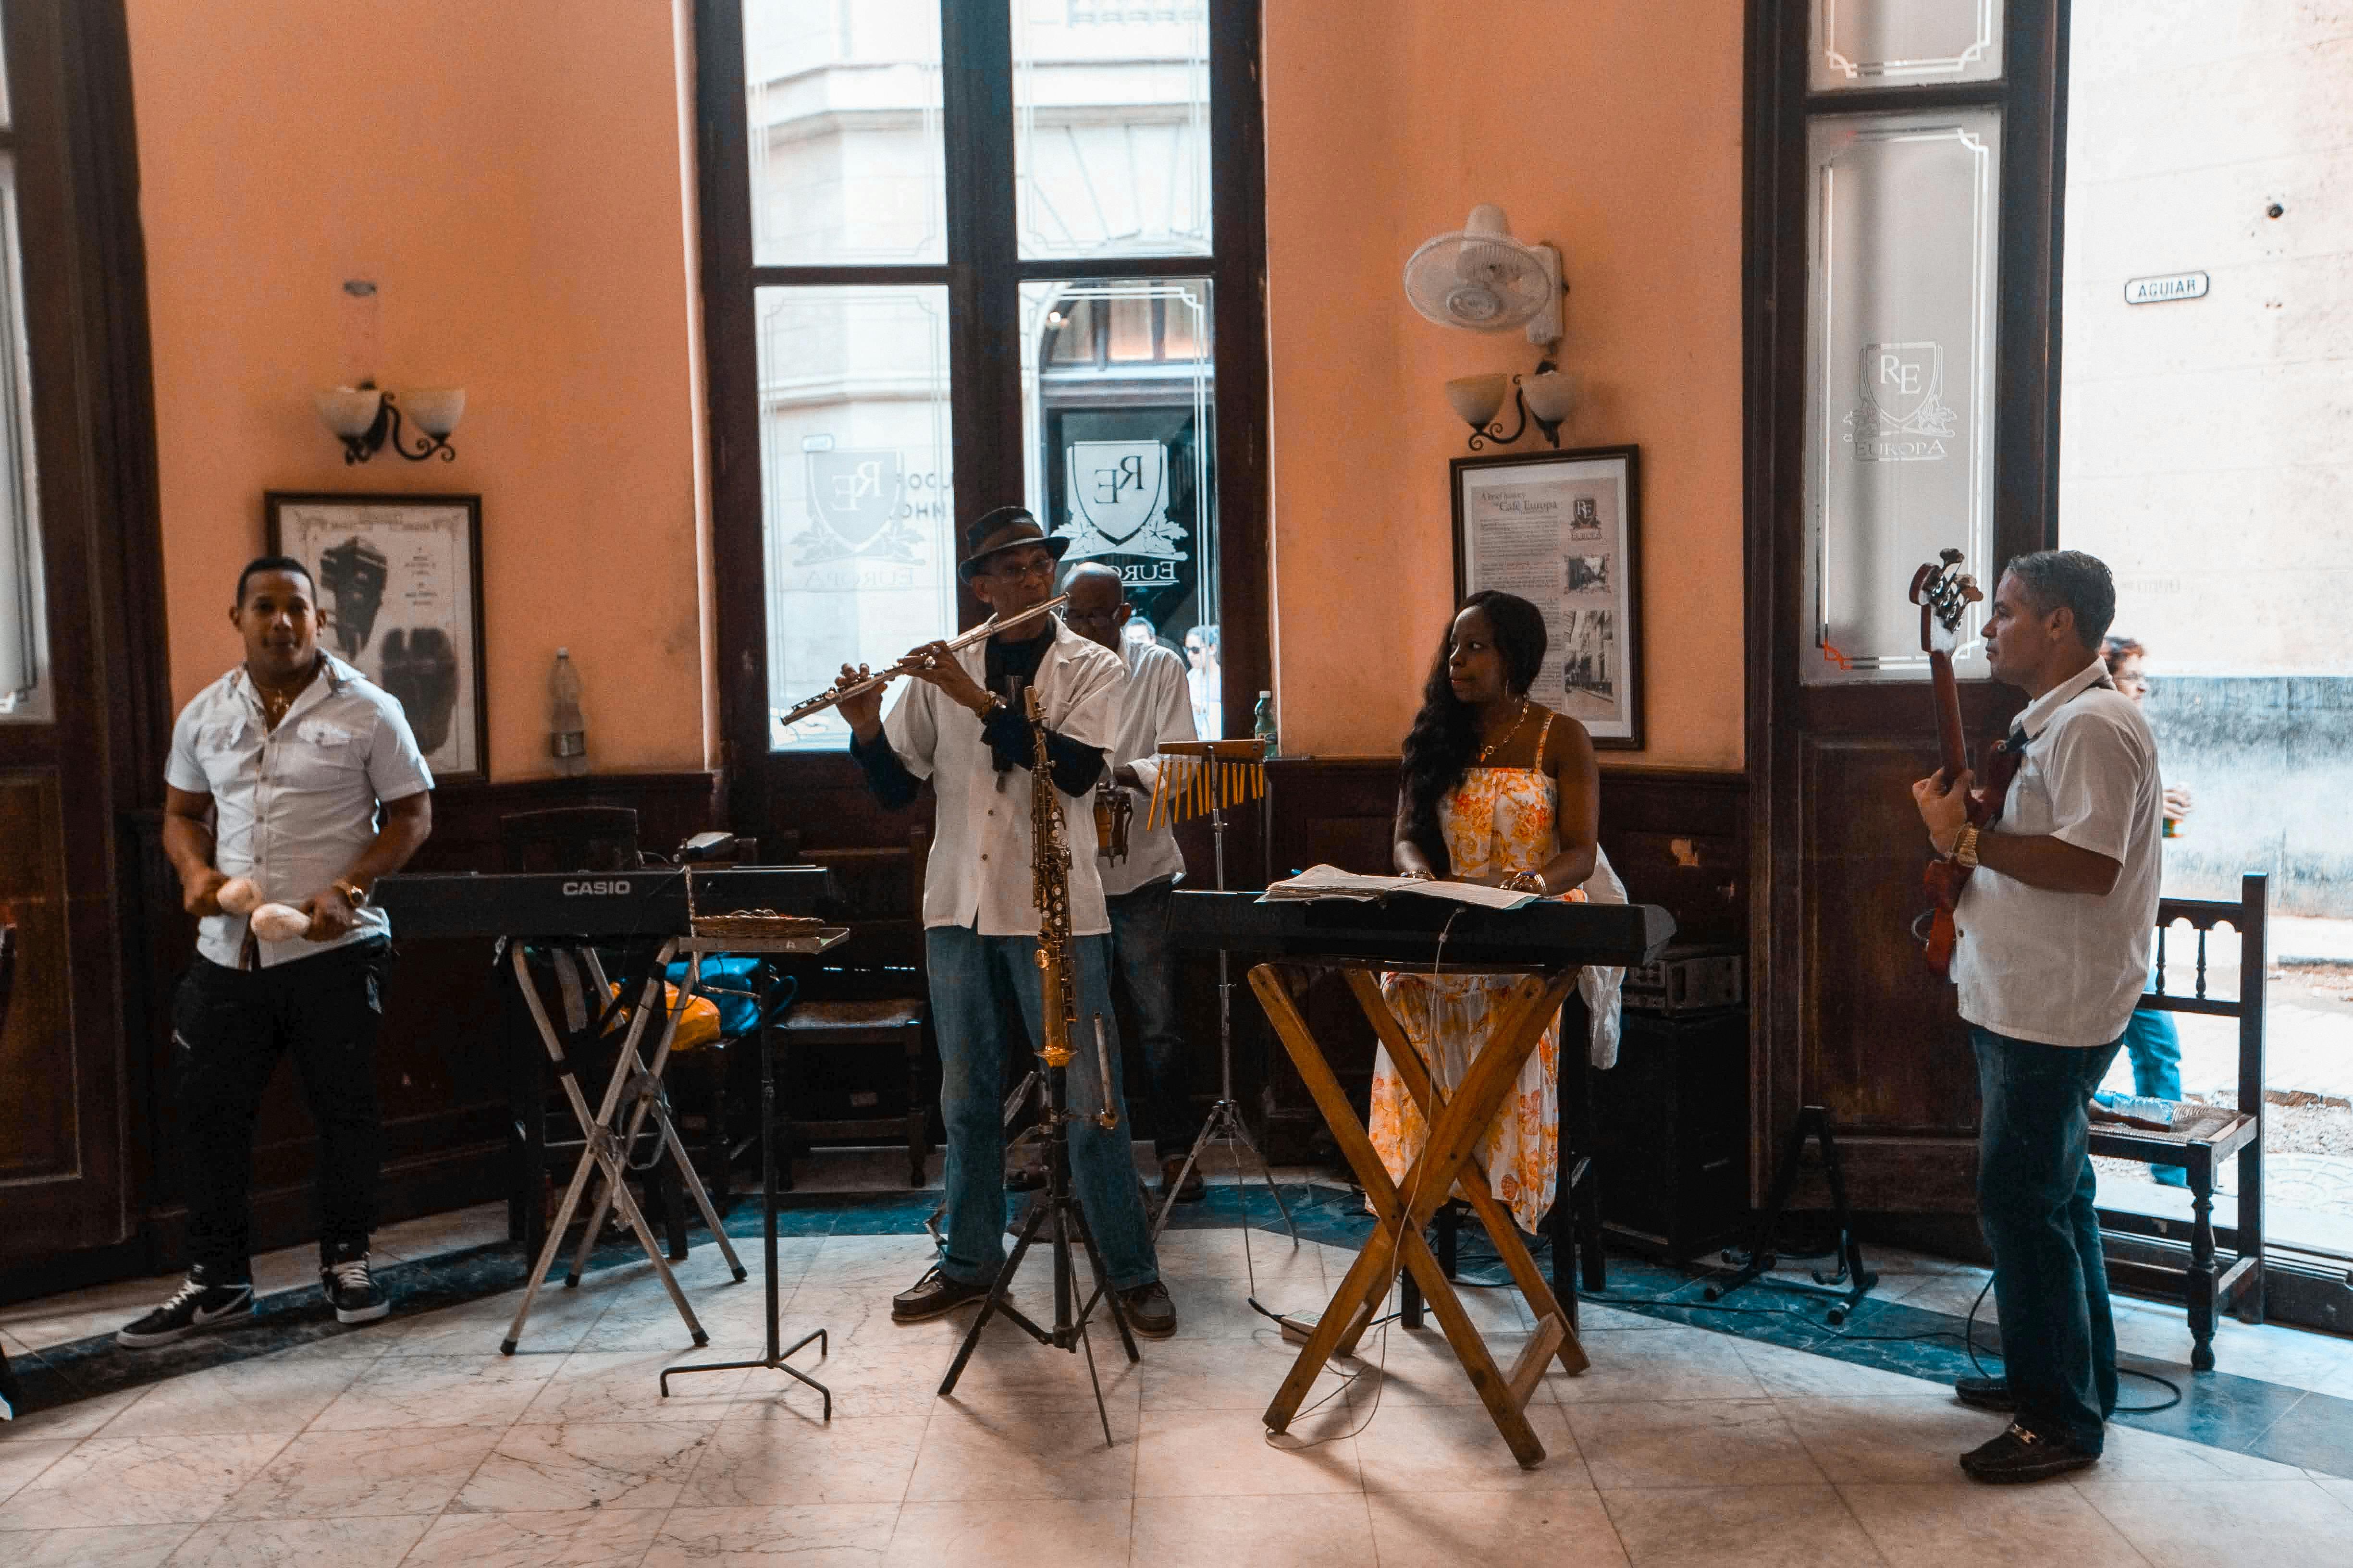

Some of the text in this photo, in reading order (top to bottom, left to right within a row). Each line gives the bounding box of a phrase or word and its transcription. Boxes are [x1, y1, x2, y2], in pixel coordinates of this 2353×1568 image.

[2138, 277, 2196, 296] AGUIAR
[1880, 355, 1922, 395] RE
[1855, 439, 1946, 456] EUROPA
[889, 503, 946, 519] OHN
[563, 881, 631, 895] CASIO
